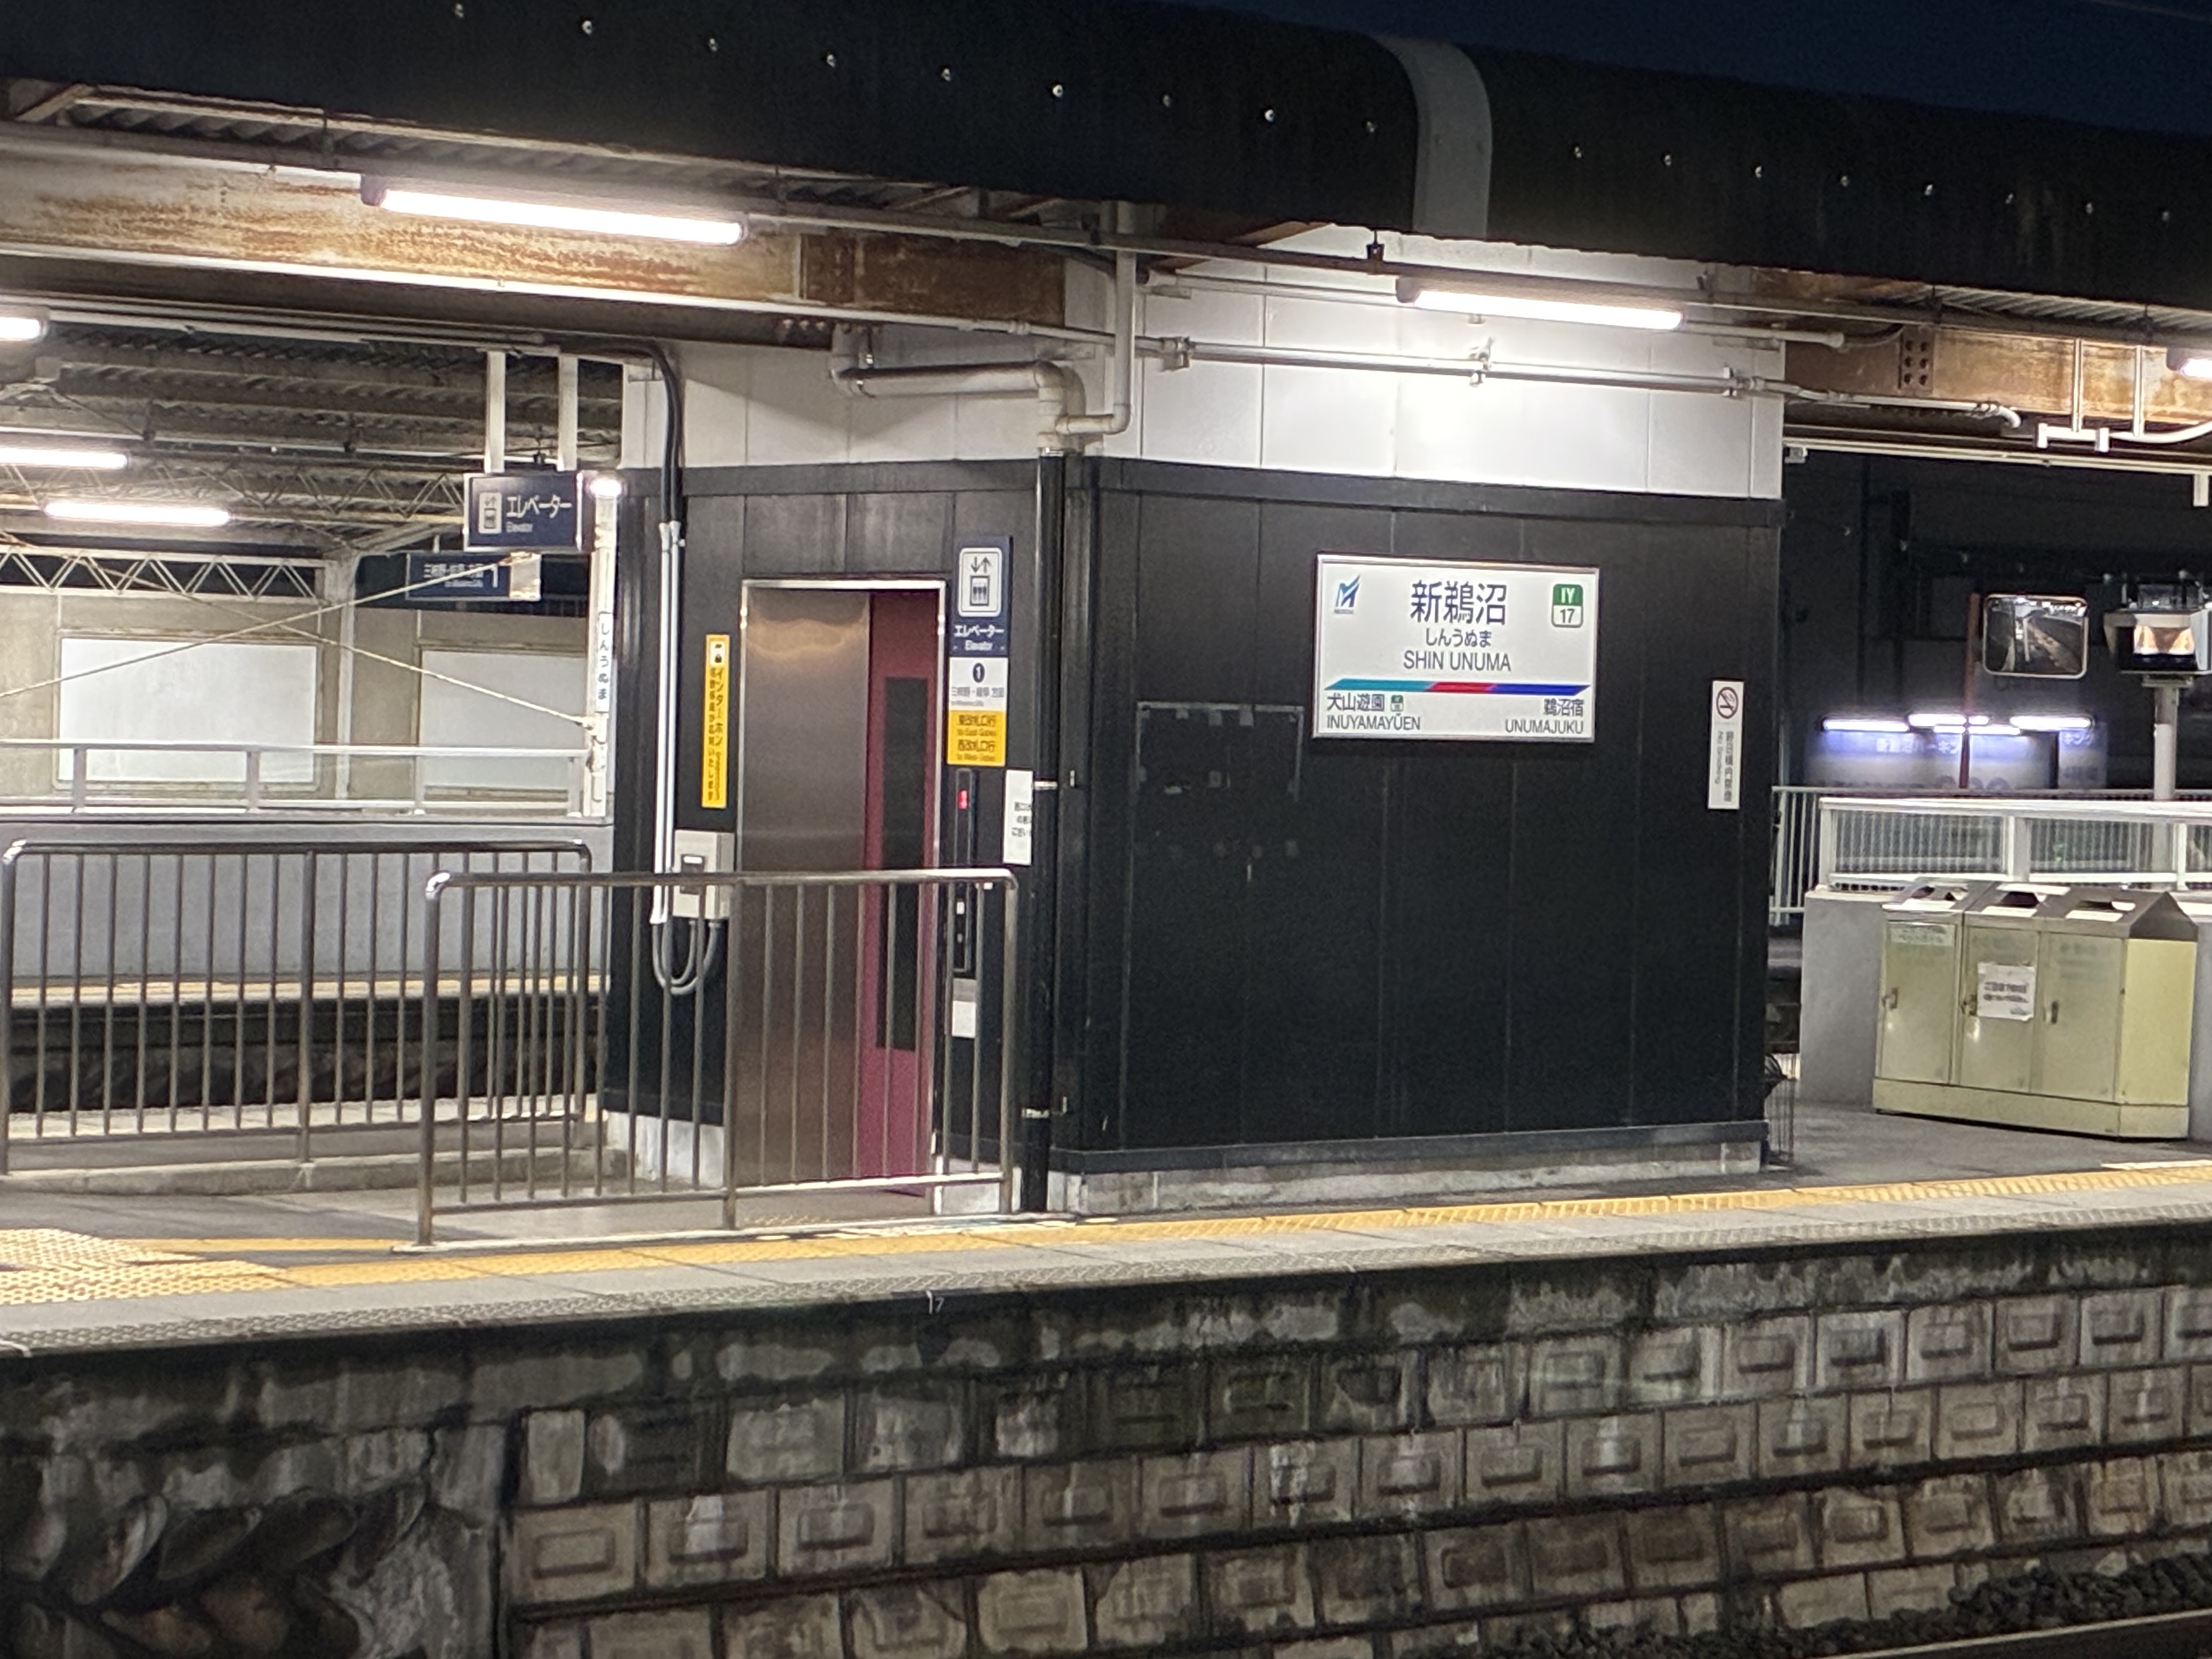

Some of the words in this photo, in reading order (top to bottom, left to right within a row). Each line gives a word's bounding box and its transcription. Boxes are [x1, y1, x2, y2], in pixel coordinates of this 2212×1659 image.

[506, 494, 573, 518] エレベーター
[1410, 579, 1507, 625] 新鵜沼
[1561, 587, 1576, 604] IY
[1560, 608, 1576, 624] 17
[953, 624, 1005, 639] エレベーター
[1426, 628, 1492, 648] しんうぬま
[597, 622, 610, 700] しんうぬま
[1403, 650, 1444, 670] SHIN
[1449, 651, 1511, 672] UNUMA
[1327, 692, 1385, 712] 犬山遊園
[1543, 698, 1584, 717] 鵜沼宿
[1505, 719, 1584, 735] UNUMAJUKU
